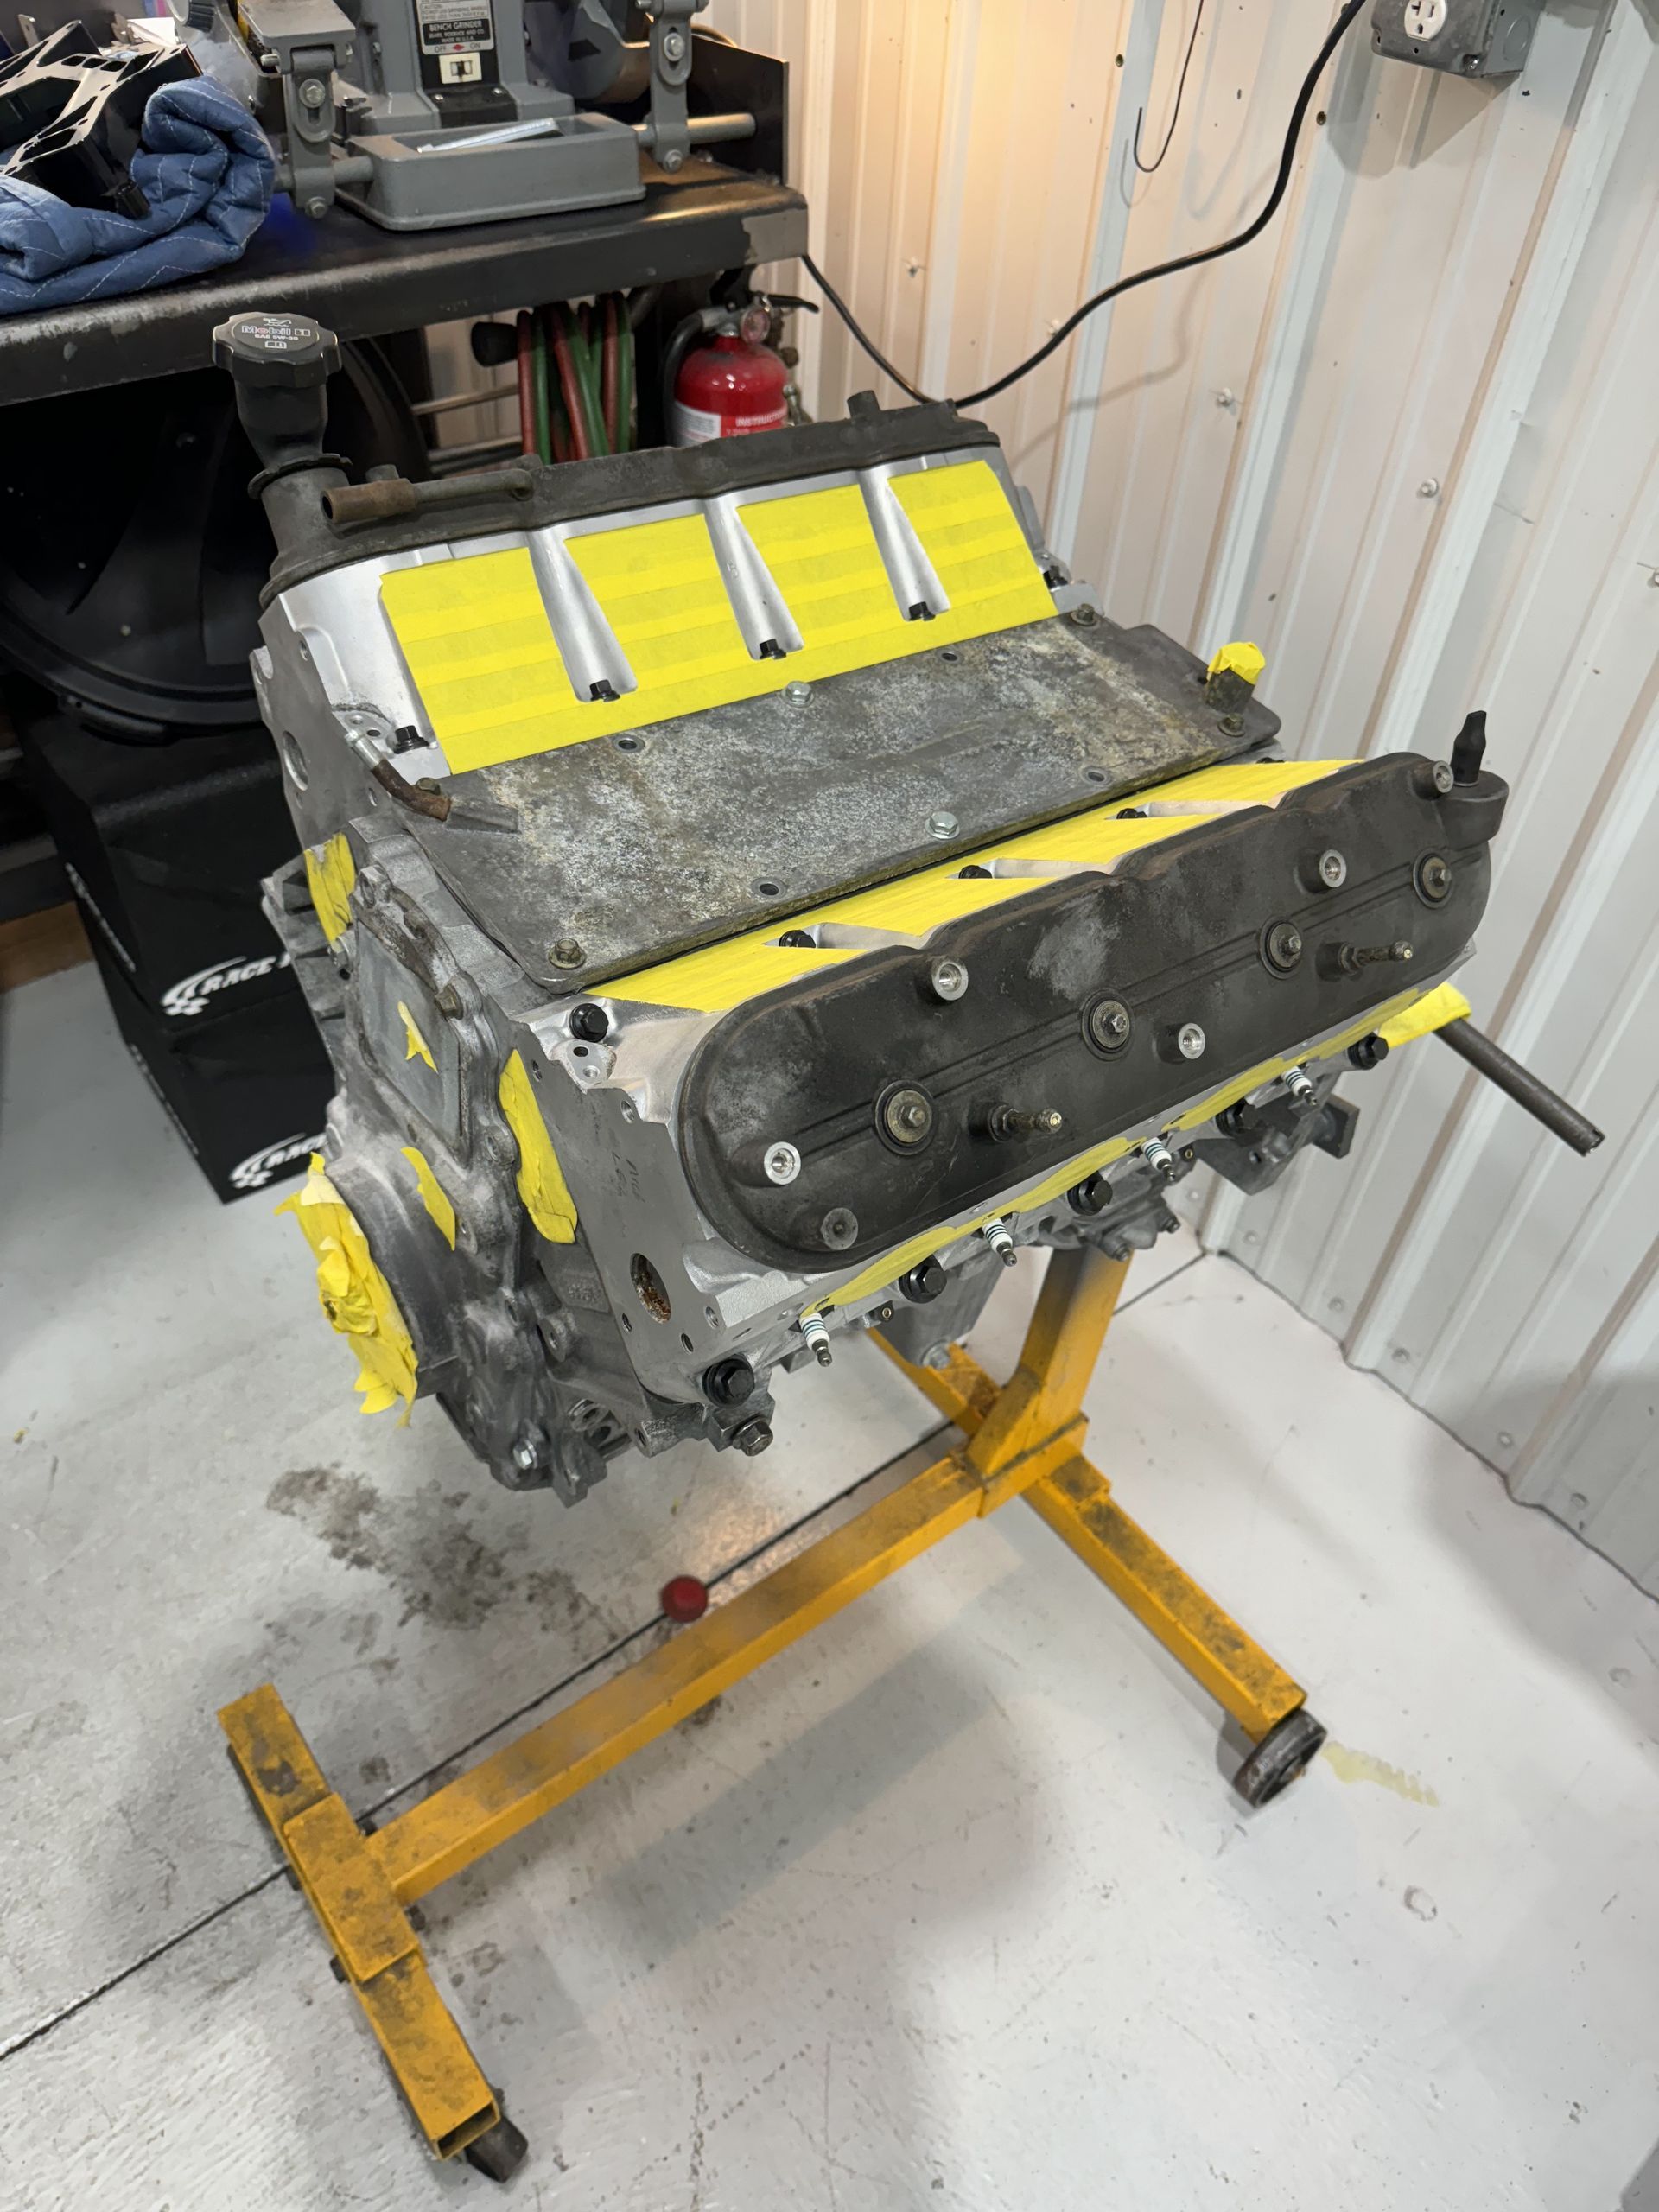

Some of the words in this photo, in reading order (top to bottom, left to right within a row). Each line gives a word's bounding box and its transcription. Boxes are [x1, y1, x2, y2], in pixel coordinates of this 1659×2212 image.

[429, 22, 452, 32] BENCH
[454, 21, 482, 29] GRINDER
[242, 325, 291, 336] Mobil
[200, 956, 277, 995] RACE
